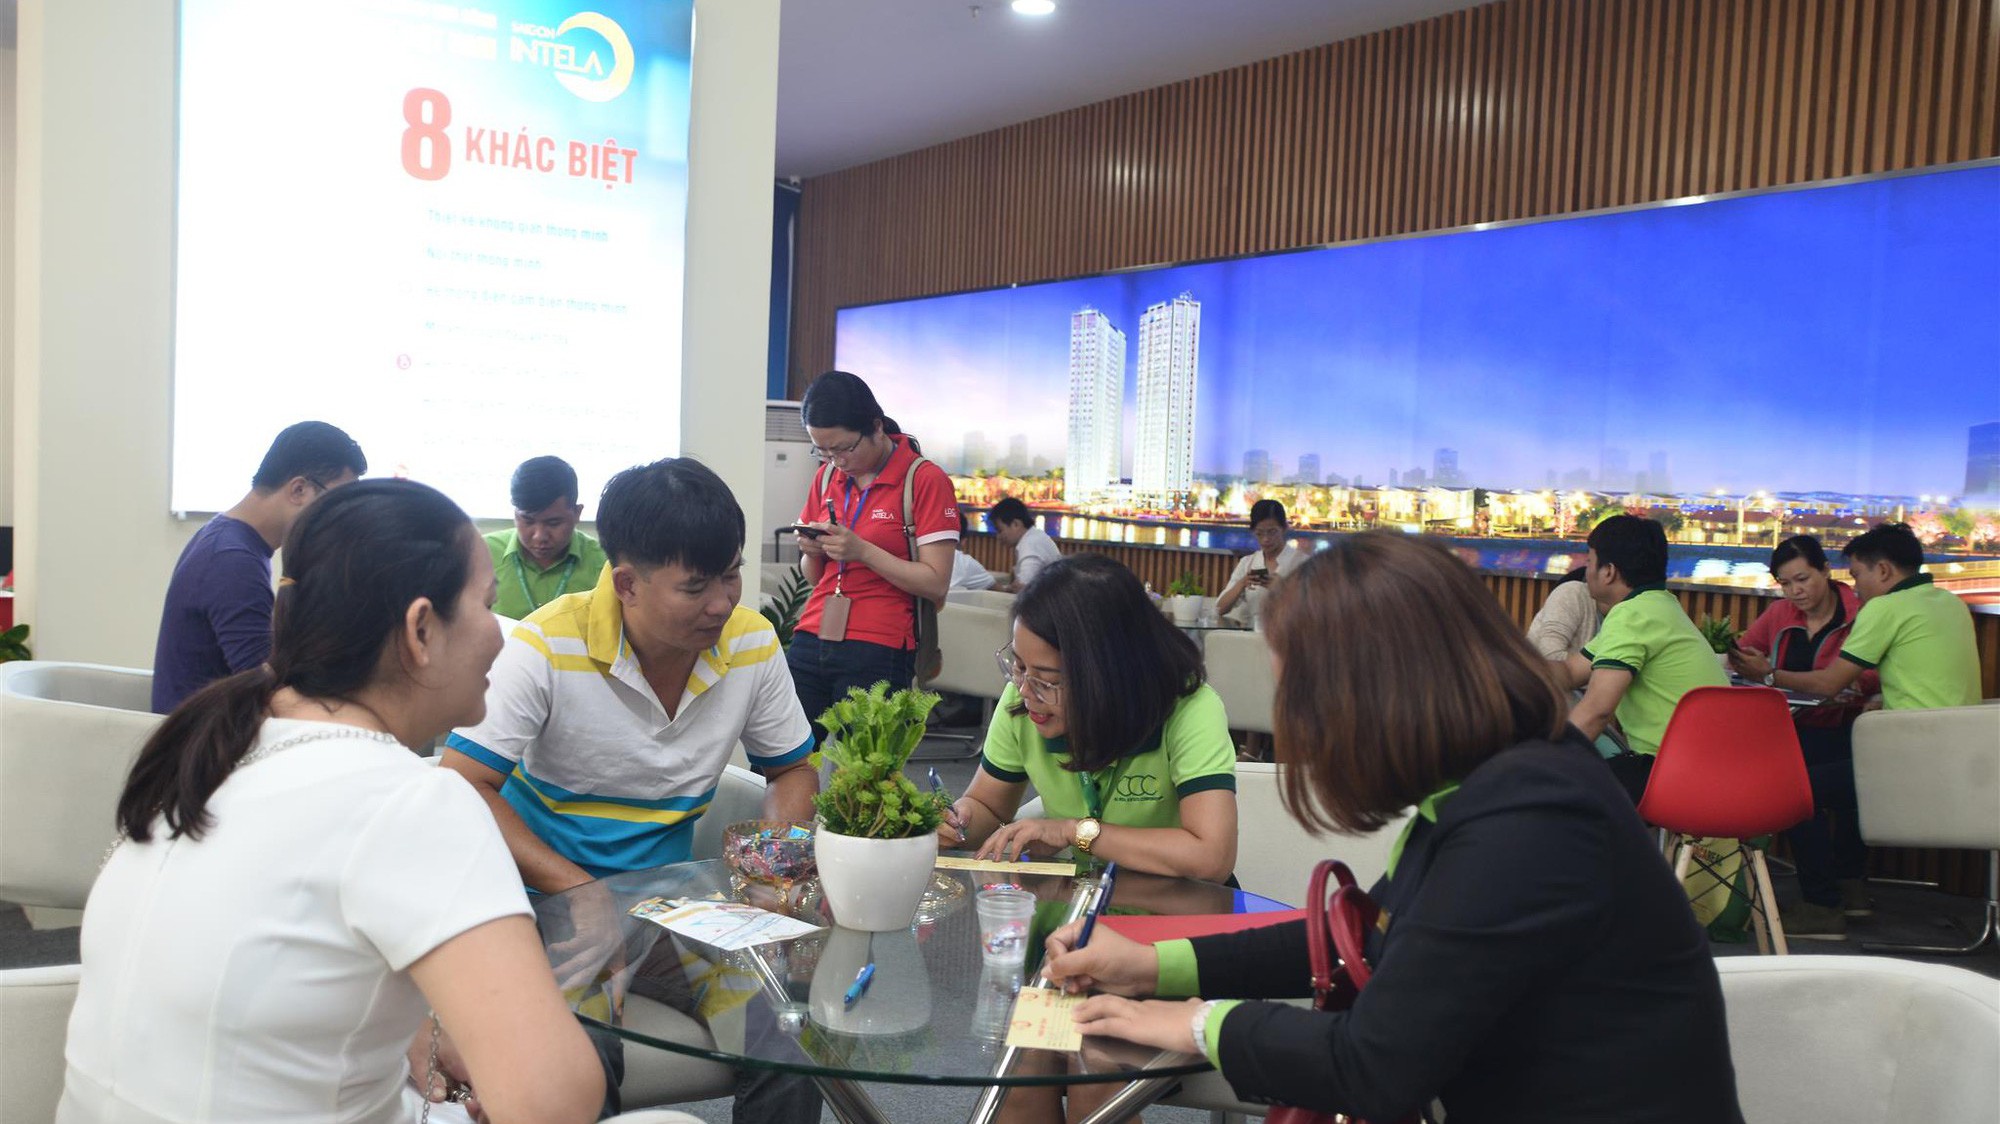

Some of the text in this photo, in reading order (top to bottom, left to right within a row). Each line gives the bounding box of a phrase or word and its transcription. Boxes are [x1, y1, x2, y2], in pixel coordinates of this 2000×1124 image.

[510, 36, 604, 76] INTELA
[401, 87, 638, 189] 8 KHÁC BIỆT
